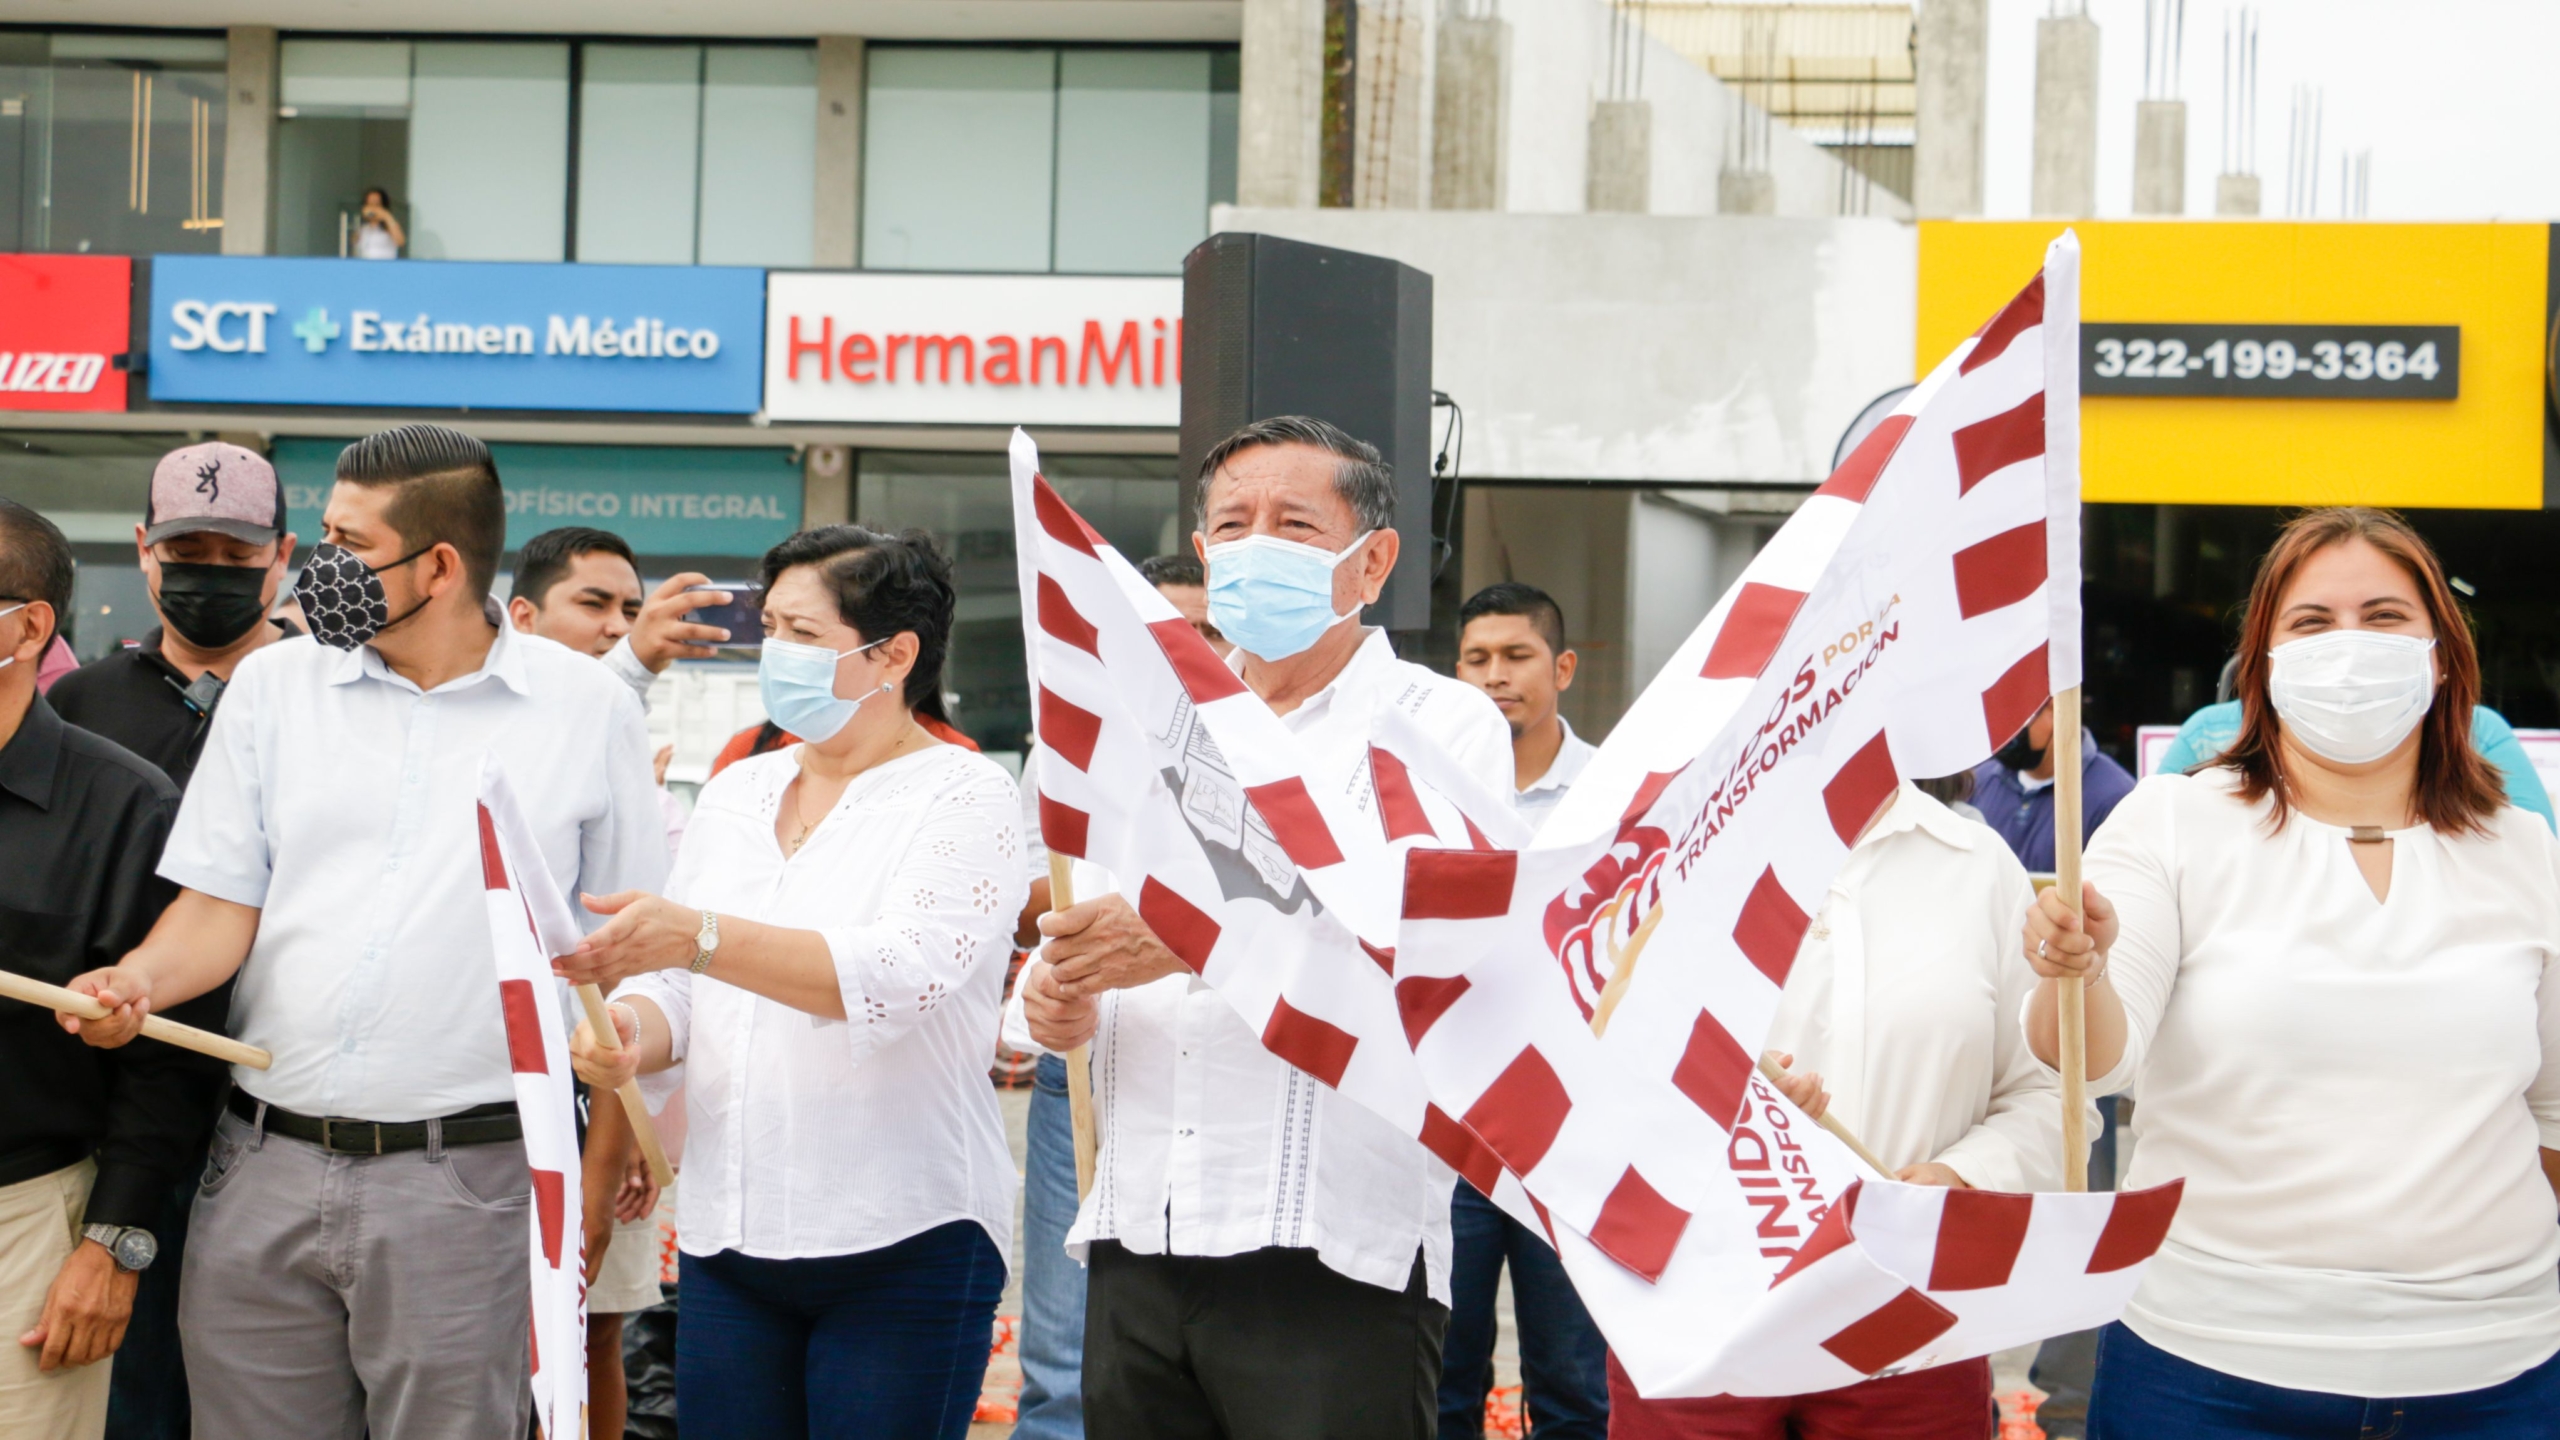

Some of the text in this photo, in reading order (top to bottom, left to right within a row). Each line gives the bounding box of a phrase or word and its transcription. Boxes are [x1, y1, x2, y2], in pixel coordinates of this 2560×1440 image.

[170, 300, 719, 359] SCT Exámen Médico
[2094, 339, 2440, 381] 322-199-3364
[630, 493, 787, 520] INTEGRAL
[1674, 652, 1816, 854] UNIDOS
[1822, 620, 1874, 668] POR
[1675, 619, 1899, 884] TRANSFORMACIÓN
